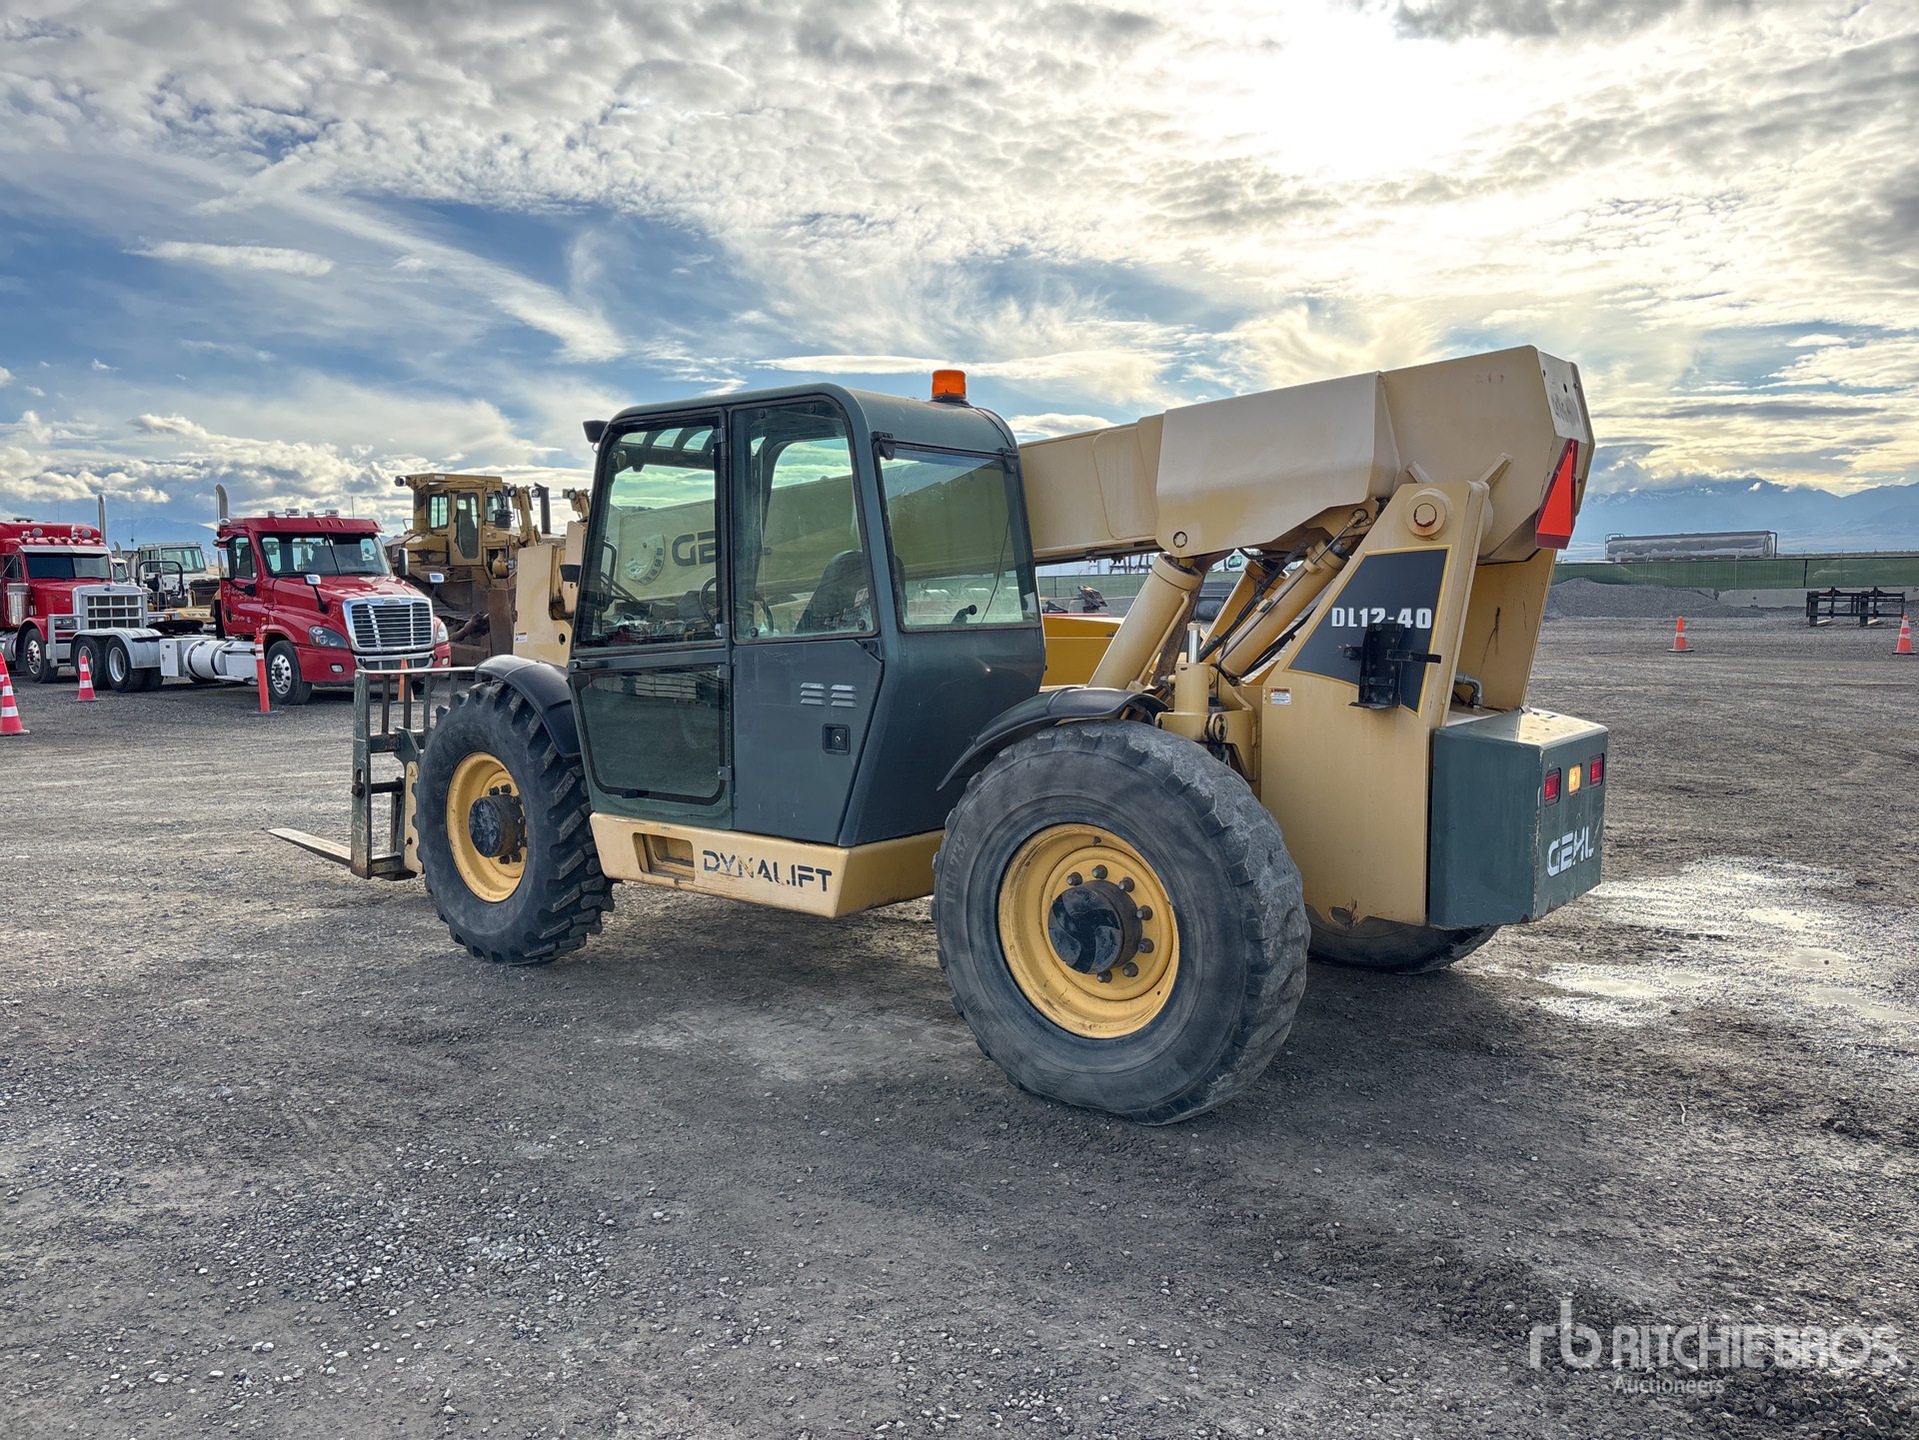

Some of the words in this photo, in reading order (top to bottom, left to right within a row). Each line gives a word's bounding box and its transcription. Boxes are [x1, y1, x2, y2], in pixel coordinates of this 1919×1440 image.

[672, 530, 716, 567] GE
[1331, 607, 1433, 630] DL12-40
[702, 849, 832, 892] DYNALIFT
[1547, 826, 1594, 877] GEHL
